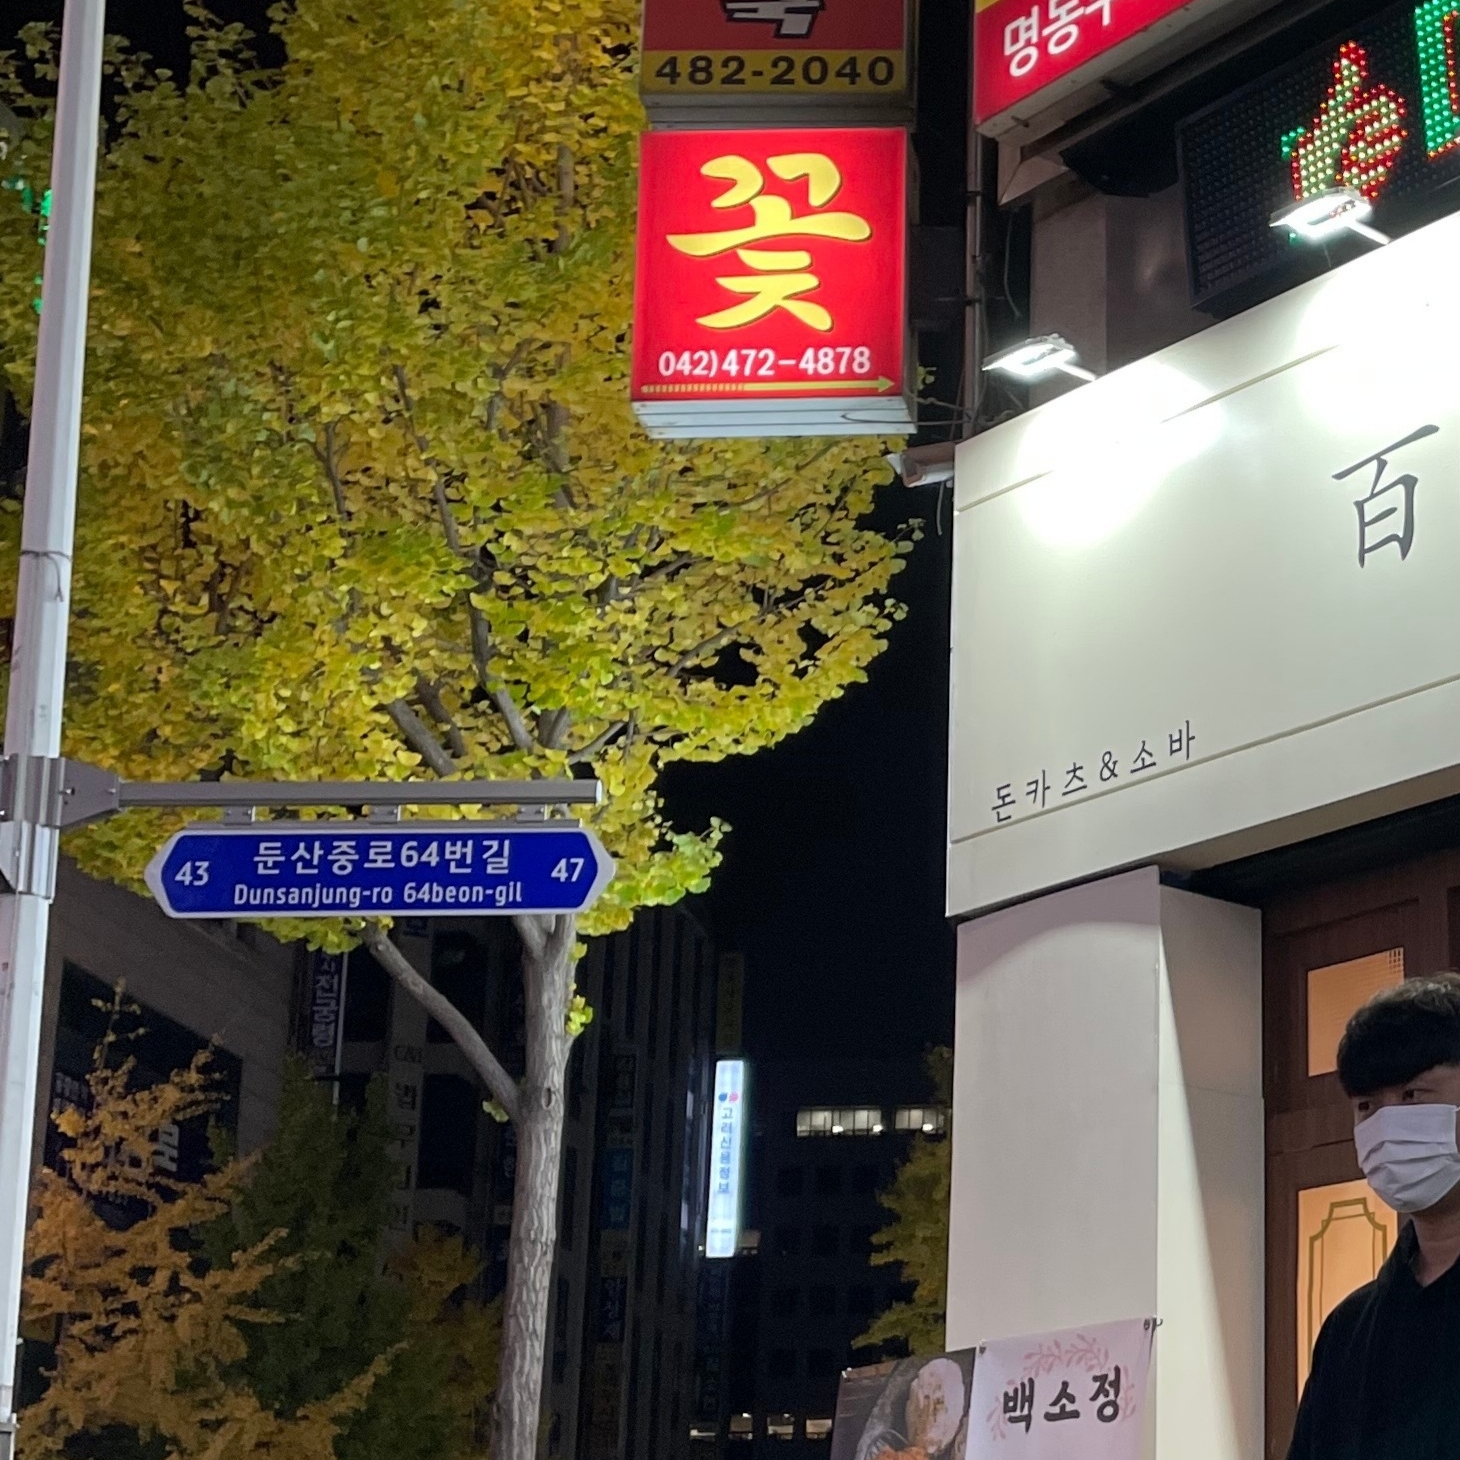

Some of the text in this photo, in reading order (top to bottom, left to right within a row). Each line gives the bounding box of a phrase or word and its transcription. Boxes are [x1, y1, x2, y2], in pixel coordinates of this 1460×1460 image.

[656, 55, 896, 87] 482-2040
[665, 152, 872, 333] 꽃
[657, 345, 872, 378] 042)472-4878
[1331, 423, 1441, 569] 百
[174, 860, 210, 887] 43
[252, 839, 511, 875] 둔산중로64번길
[550, 857, 586, 884] 47
[233, 881, 522, 909] Dunsanjung-ro 64beon-gil
[1002, 1365, 1122, 1434] 백소정
